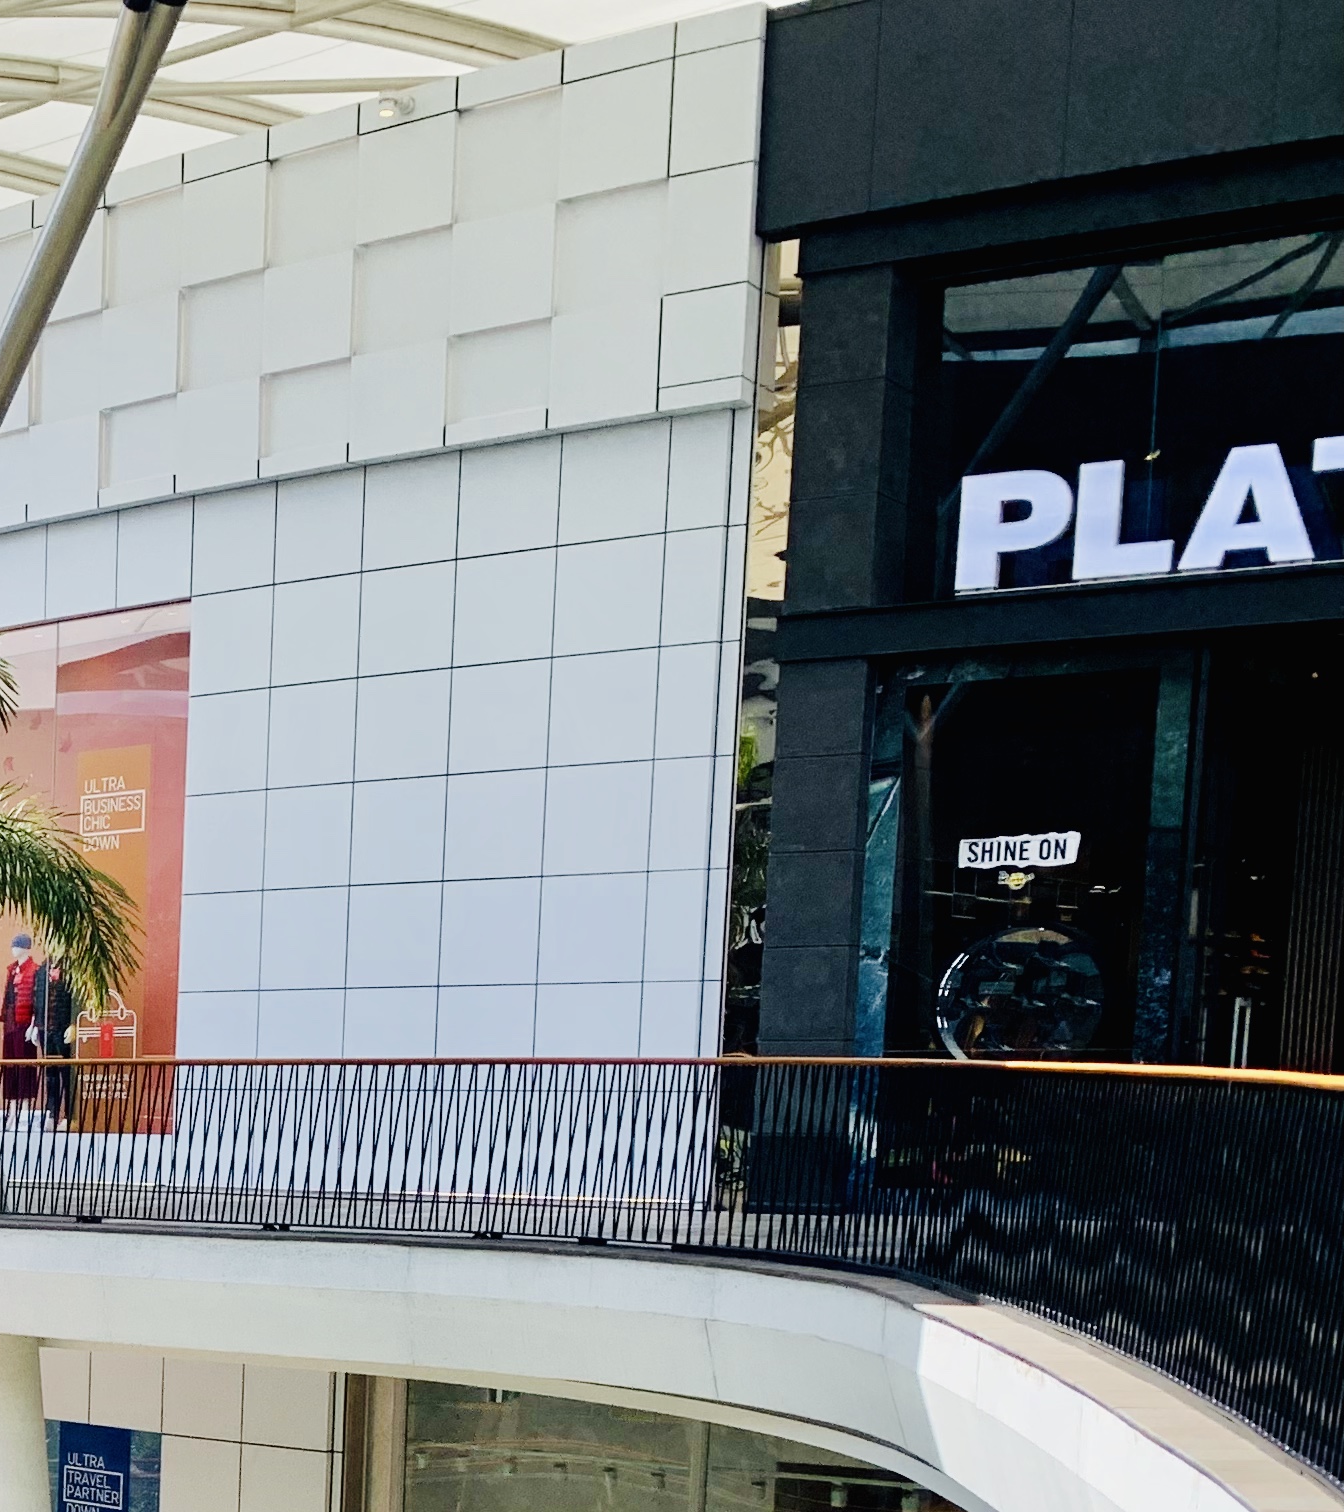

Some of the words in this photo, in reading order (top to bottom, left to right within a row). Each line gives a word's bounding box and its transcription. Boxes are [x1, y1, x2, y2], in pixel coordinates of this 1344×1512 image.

[955, 435, 1344, 590] PLA
[84, 776, 125, 794] ULTRA
[84, 795, 141, 815] BUSINESS
[84, 815, 110, 831] CHIC
[83, 835, 120, 852] DOWN
[967, 841, 1030, 863] SHINE
[1039, 838, 1067, 860] ON
[68, 1452, 105, 1469] ULTRA
[68, 1470, 111, 1489] TRAVEL
[67, 1484, 119, 1504] PARTNER
